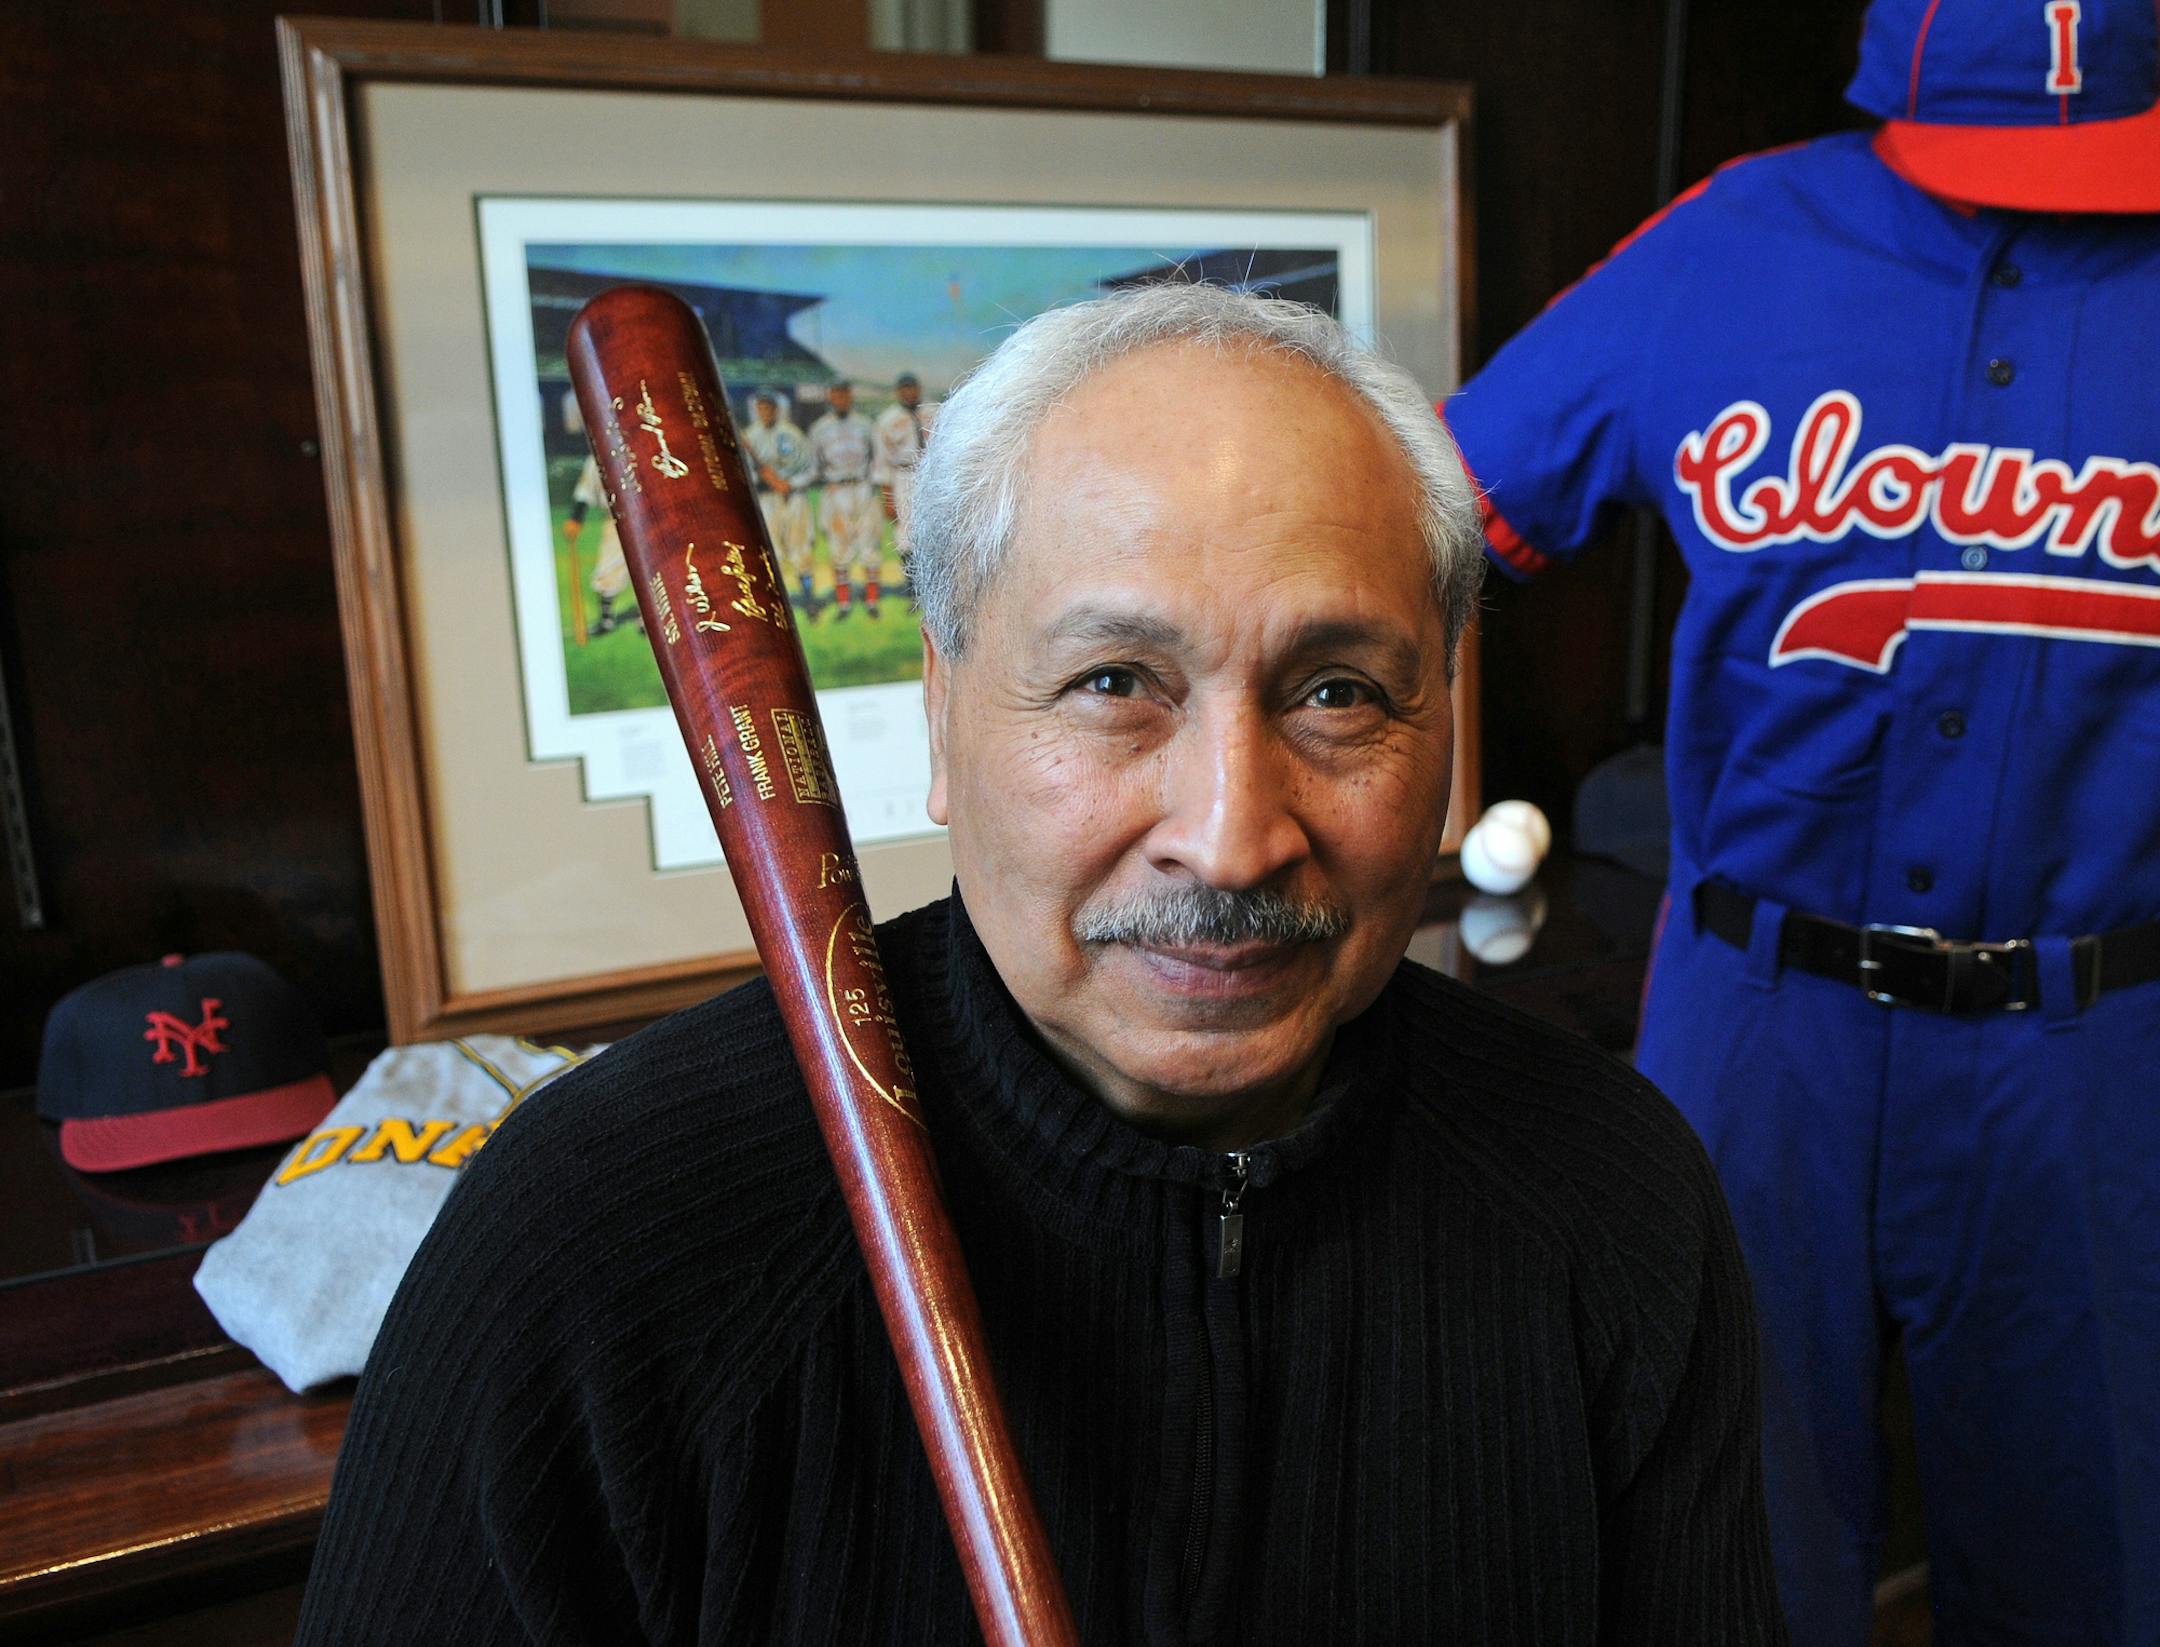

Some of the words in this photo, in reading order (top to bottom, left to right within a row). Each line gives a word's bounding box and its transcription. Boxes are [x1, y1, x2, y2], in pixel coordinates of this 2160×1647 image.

[2045, 0, 2081, 94] I
[1675, 390, 2160, 576] Clown
[700, 734, 721, 770] HILL
[729, 702, 762, 753] GRANT
[746, 754, 777, 801] FRANK
[776, 711, 811, 798] NATIONAL
[710, 767, 734, 809] PETE
[844, 987, 873, 1027] 125
